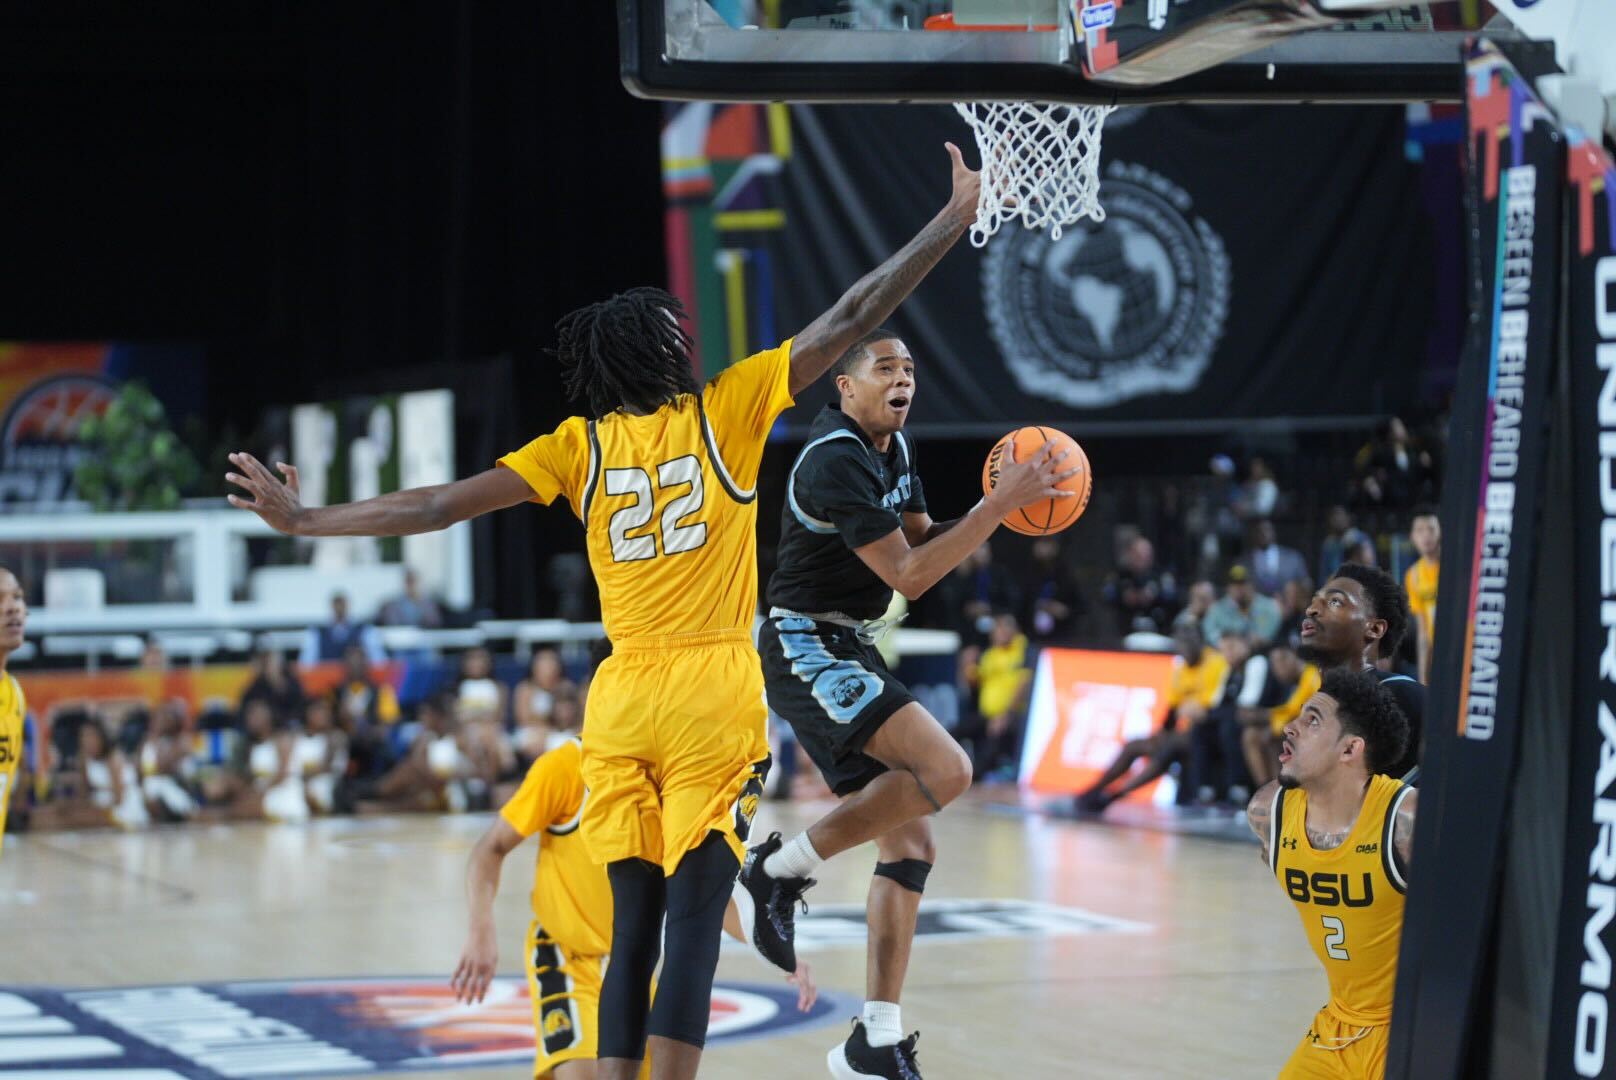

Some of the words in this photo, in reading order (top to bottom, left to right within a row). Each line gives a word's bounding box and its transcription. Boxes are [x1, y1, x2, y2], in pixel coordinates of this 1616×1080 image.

[605, 454, 708, 563] 22
[1356, 843, 1378, 854] CIAA
[1285, 867, 1374, 908] BSU
[1321, 914, 1350, 961] 2
